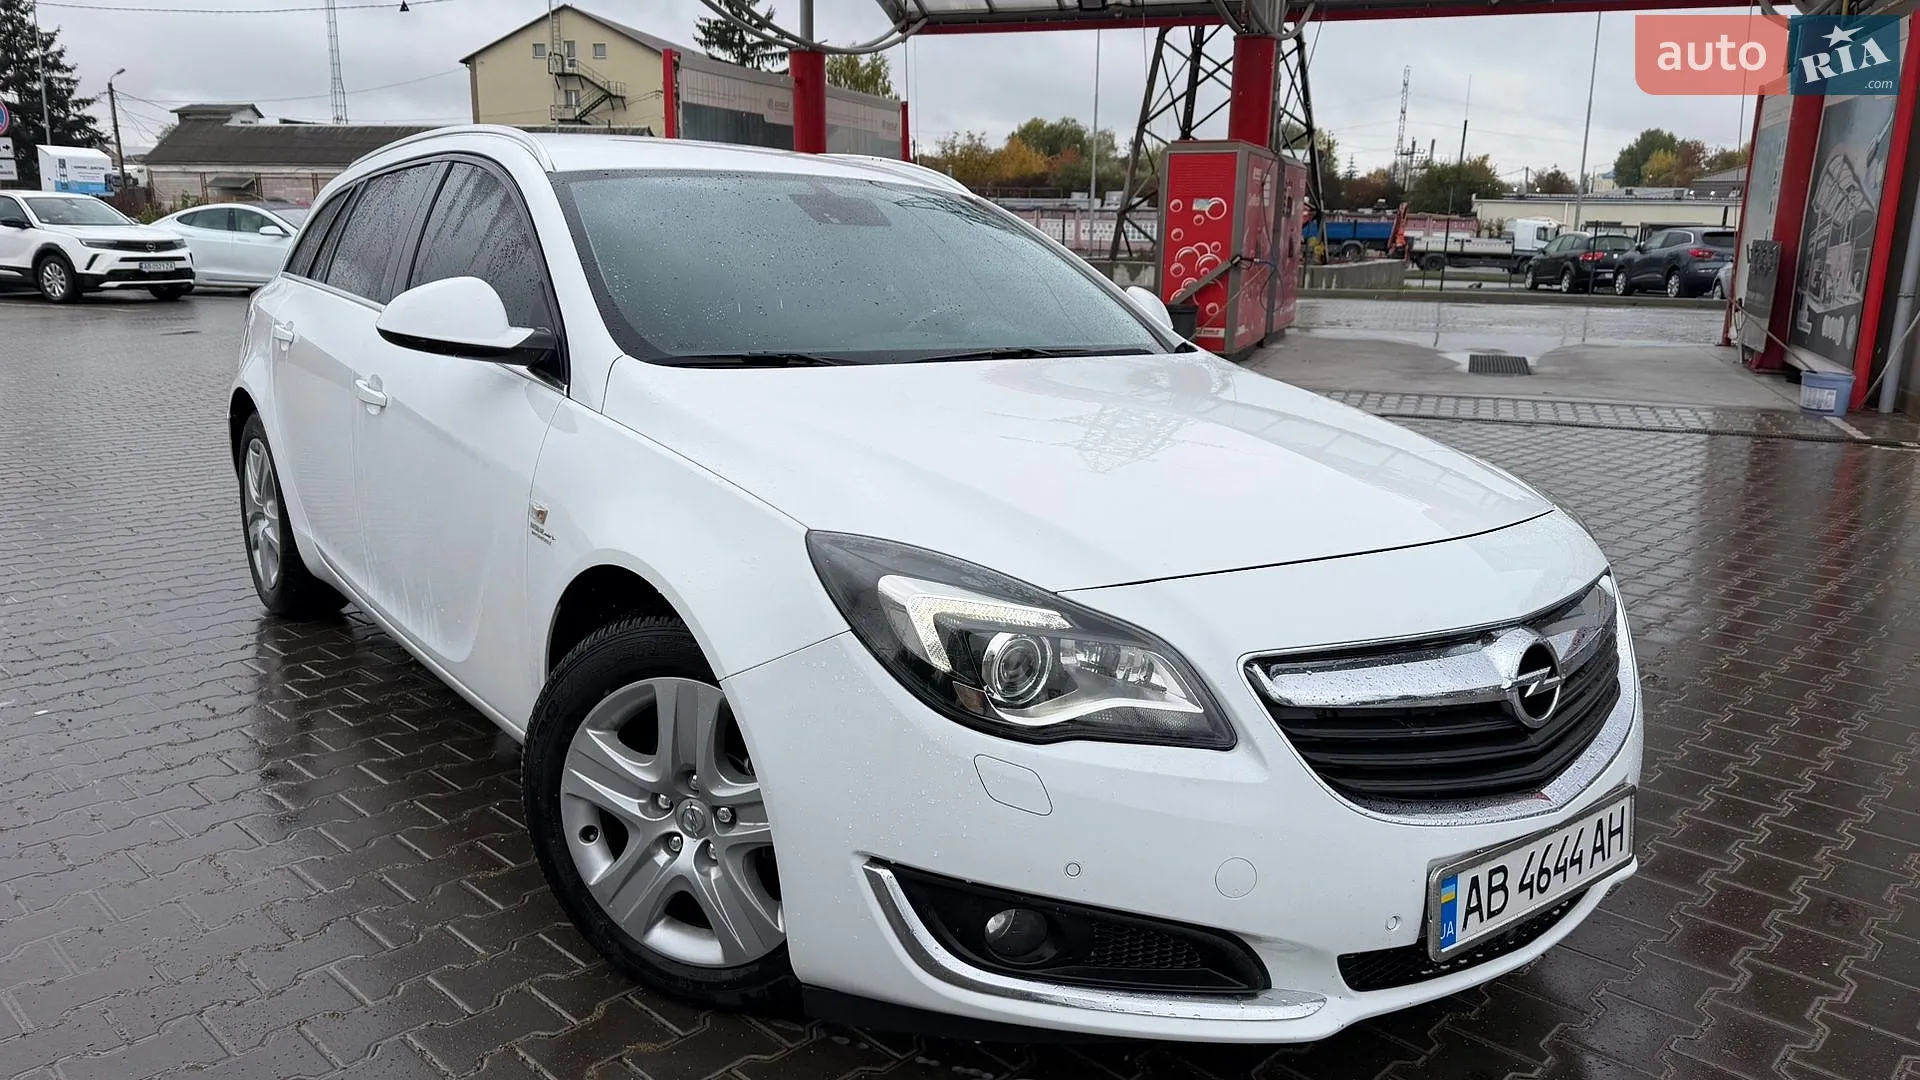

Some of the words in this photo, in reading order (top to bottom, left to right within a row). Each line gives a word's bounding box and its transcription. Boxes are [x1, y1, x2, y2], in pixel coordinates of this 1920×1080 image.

[1462, 864, 1509, 931] AB
[1518, 827, 1585, 900] 4644
[1589, 805, 1625, 869] AH
